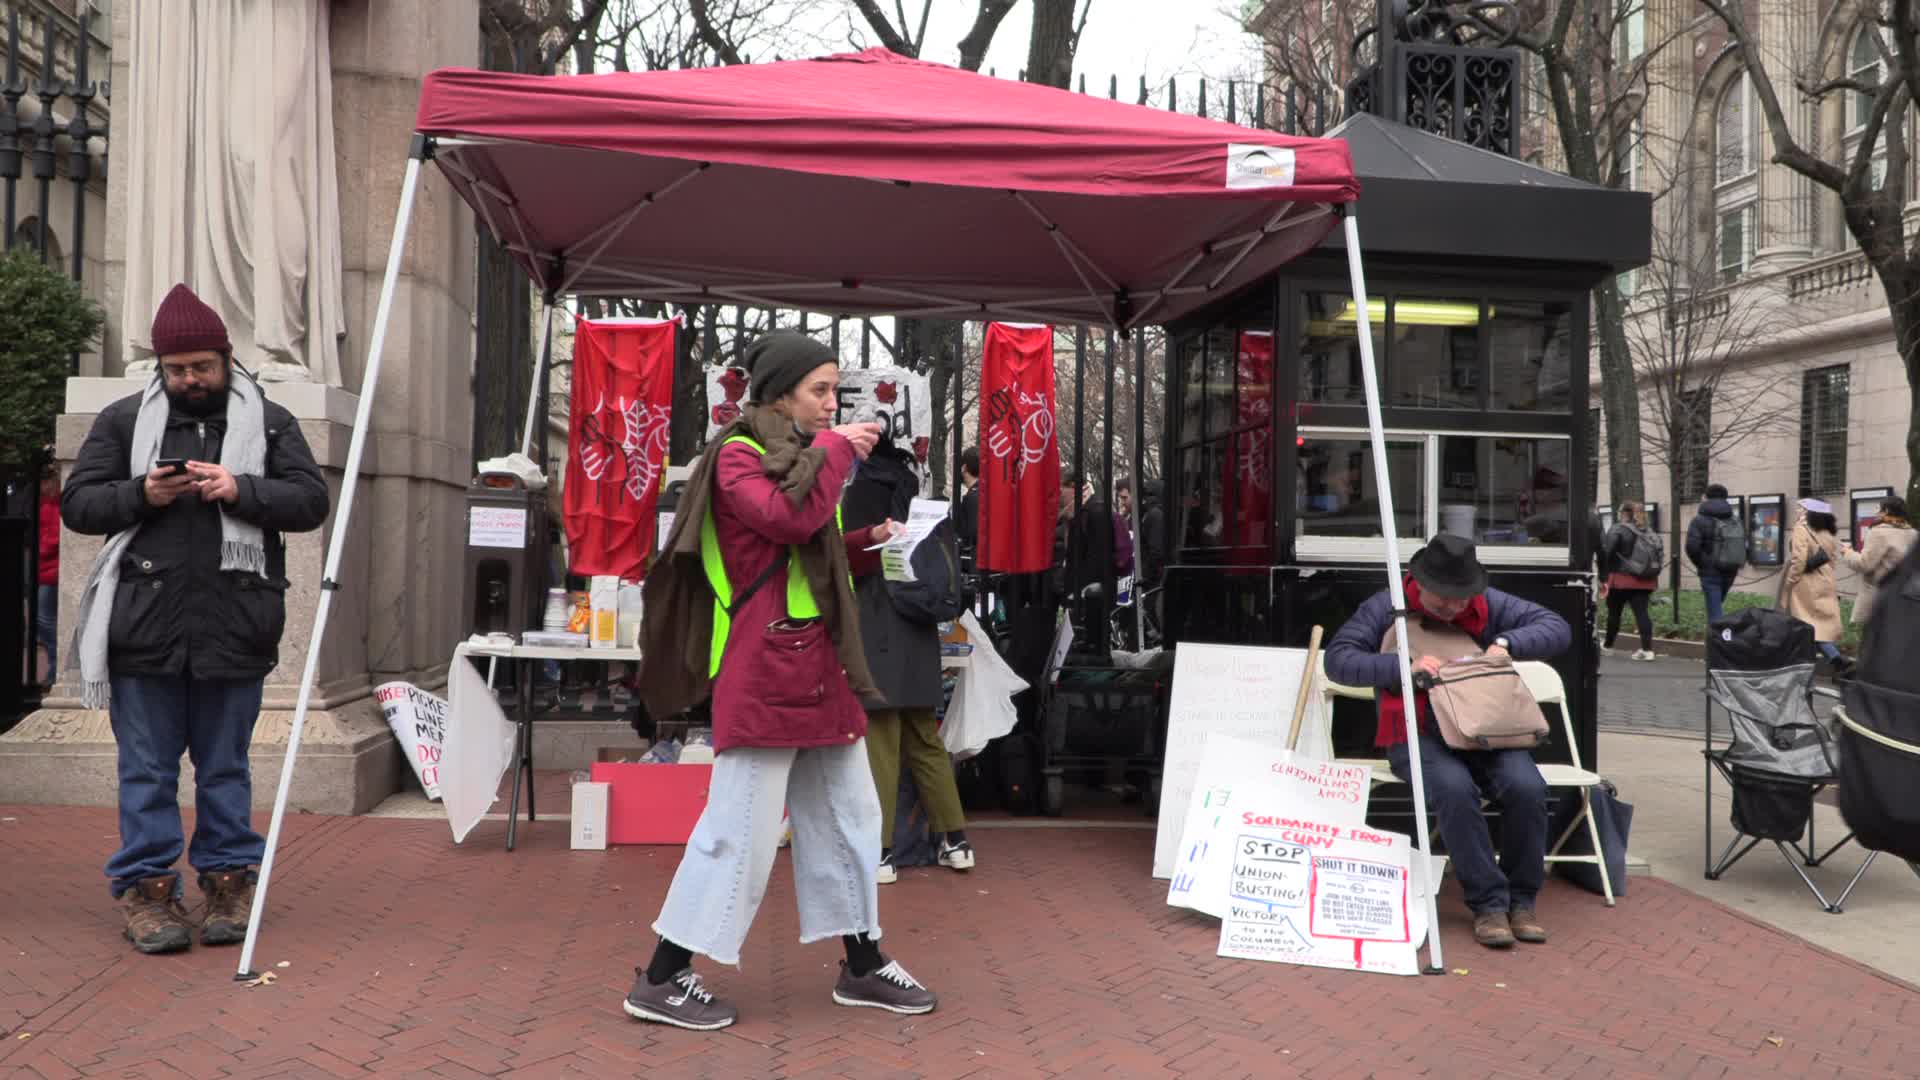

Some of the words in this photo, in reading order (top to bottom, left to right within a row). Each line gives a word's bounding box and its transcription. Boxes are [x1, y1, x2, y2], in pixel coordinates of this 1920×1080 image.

[407, 687, 448, 717] PICKE
[1242, 811, 1340, 837] SOLIDARITY
[1351, 829, 1393, 847] FROM
[1281, 830, 1335, 849] CUNY
[1243, 840, 1305, 860] STOP
[1315, 856, 1343, 870] SHUT
[1347, 862, 1357, 873] IT
[1361, 864, 1399, 880] DOWN!
[1235, 881, 1305, 901] BUSTING!
[1231, 906, 1288, 925] VICTORY
